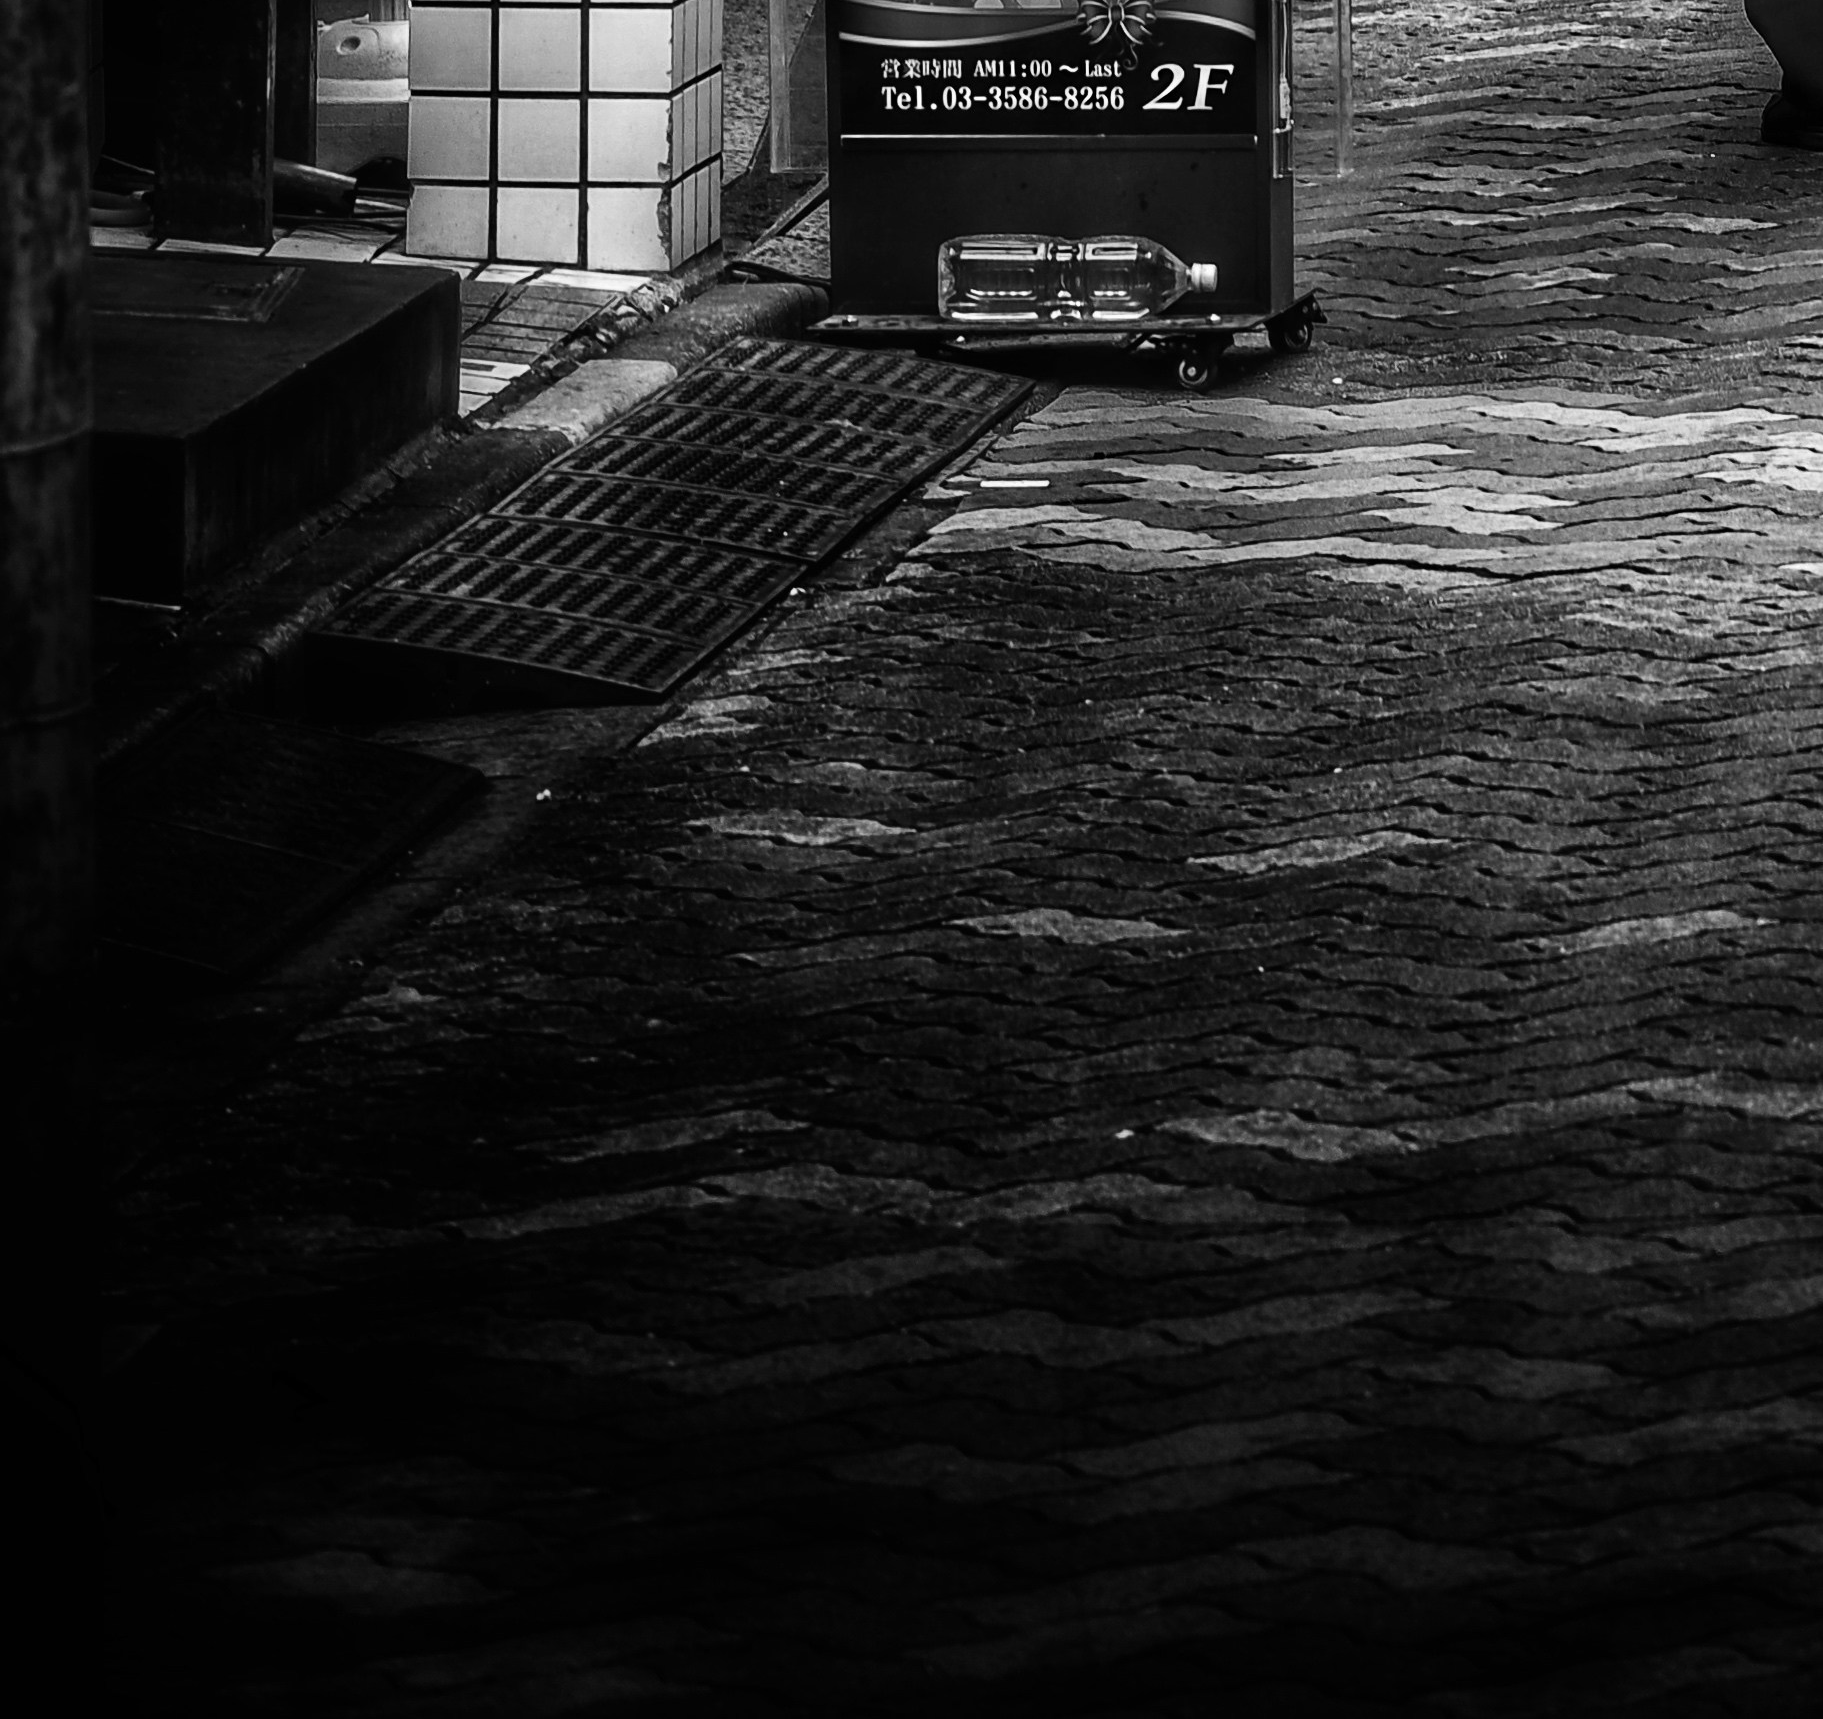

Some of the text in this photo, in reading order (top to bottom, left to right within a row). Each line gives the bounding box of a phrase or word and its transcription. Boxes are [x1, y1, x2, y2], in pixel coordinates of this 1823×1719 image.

[881, 59, 962, 79] 営業時間
[974, 59, 1052, 78] AM11:00
[1084, 59, 1122, 78] Last
[1142, 62, 1236, 112] 2F
